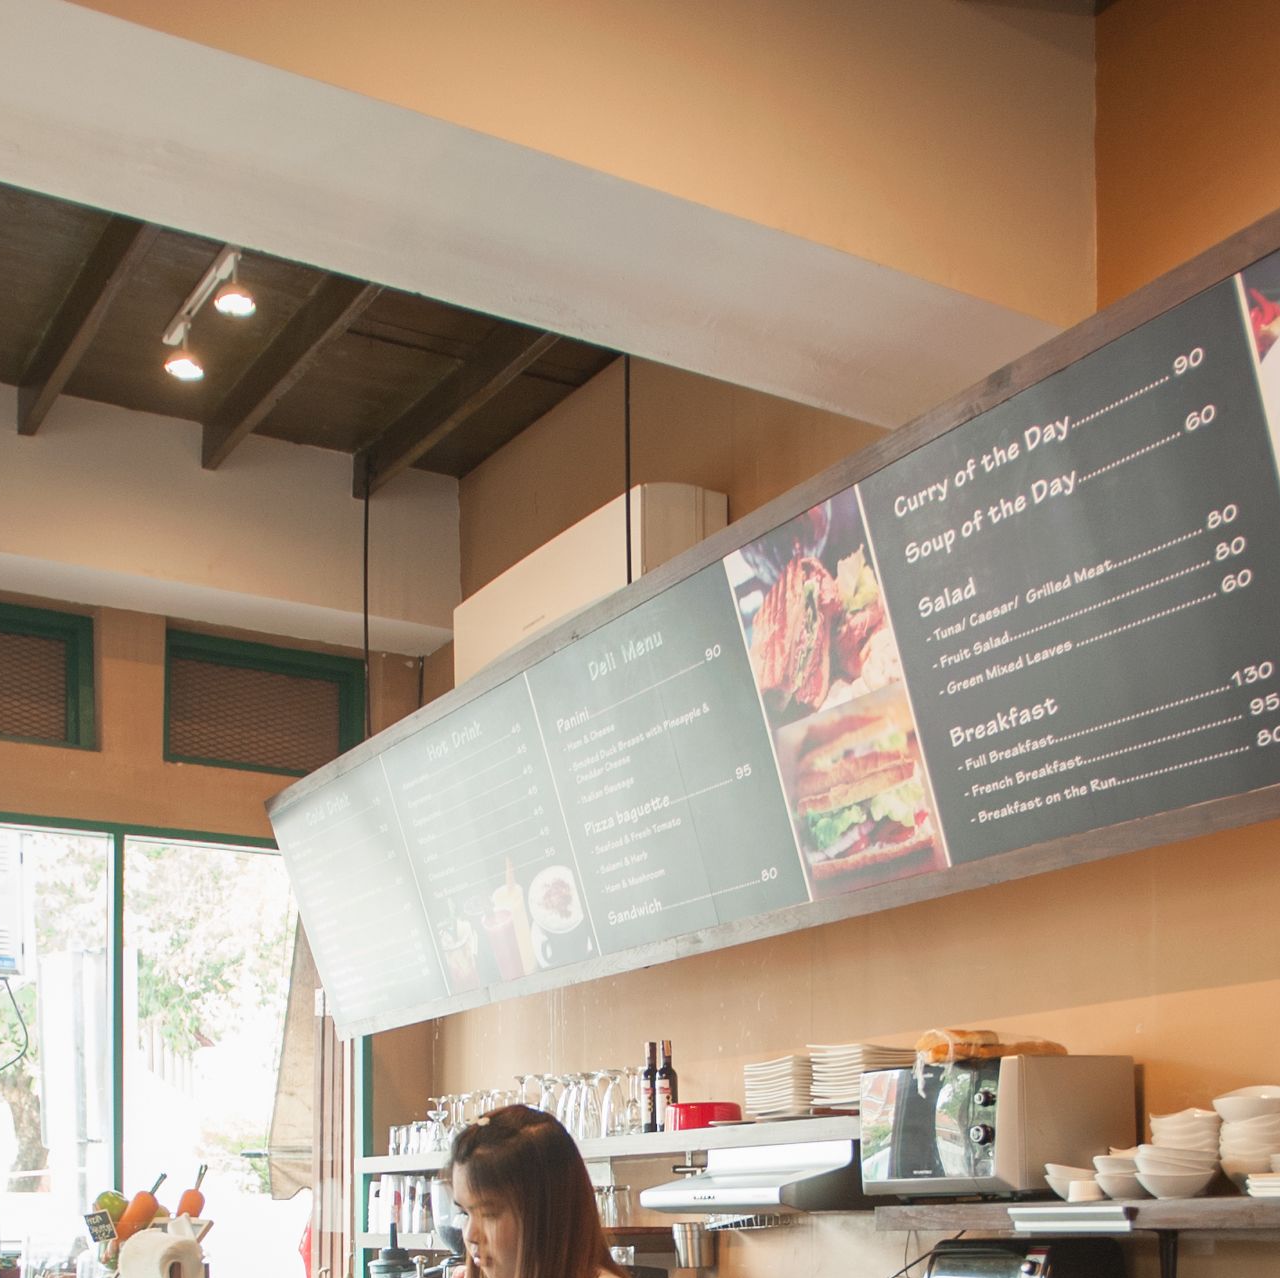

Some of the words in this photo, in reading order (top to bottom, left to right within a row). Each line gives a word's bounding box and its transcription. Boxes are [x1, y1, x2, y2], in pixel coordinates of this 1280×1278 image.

[894, 480, 948, 517] Curry
[955, 459, 977, 488] of
[981, 440, 1020, 473] the
[1024, 414, 1071, 452] Day
[1173, 346, 1205, 376] 90
[905, 530, 955, 563] Soup
[961, 511, 984, 541] of
[988, 491, 1027, 524] the
[1031, 468, 1077, 505] Day
[1185, 403, 1216, 432] 60
[918, 577, 977, 618] Salad
[932, 615, 966, 643] Tuna/
[969, 596, 1019, 628] Caesar/
[1025, 572, 1072, 604] Grilled
[1074, 558, 1113, 585] Meat
[1206, 504, 1237, 530] 80
[939, 646, 971, 671] Fruit
[973, 631, 1010, 659] Salad
[1214, 535, 1246, 562] 80
[588, 651, 617, 682] Deli
[620, 631, 663, 664] Menu
[946, 671, 984, 697] Green
[985, 656, 1023, 685] Mixed
[1026, 641, 1073, 669] Leaves
[1221, 568, 1253, 593] 60
[451, 719, 484, 749] Drink
[556, 706, 590, 735] Panini
[704, 643, 722, 662] 90
[949, 697, 1059, 747] Breakfast
[964, 750, 990, 772] Full
[990, 732, 1054, 766] Breakfast
[1231, 660, 1274, 687] 130
[971, 775, 1014, 799] French
[1015, 755, 1083, 789] Breakfast
[1249, 692, 1280, 716] 95
[584, 815, 615, 837] Pizza
[616, 794, 670, 825] baguette
[735, 763, 752, 780] 95
[978, 794, 1043, 824] Breakfast
[1045, 791, 1062, 806] on
[1063, 781, 1088, 801] the
[1090, 774, 1117, 792] Run
[608, 896, 663, 926] Sandwich
[760, 866, 779, 882] 80
